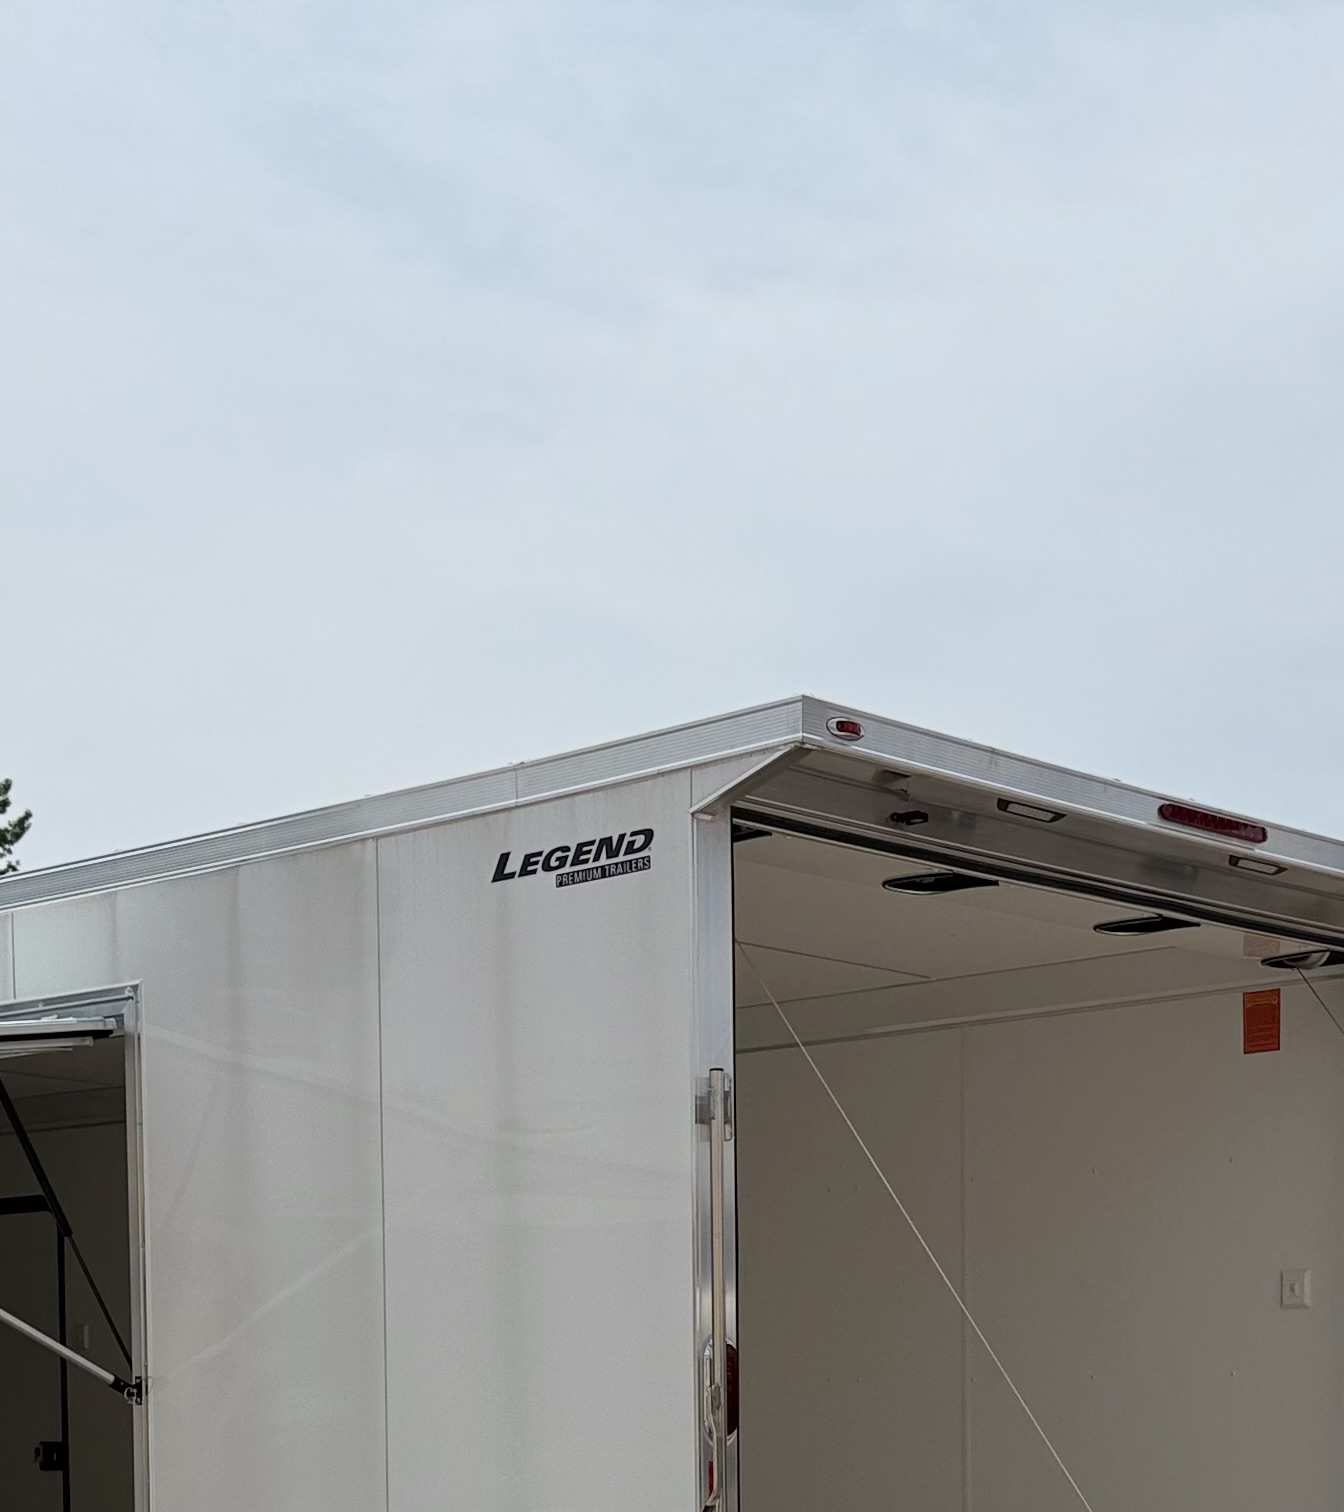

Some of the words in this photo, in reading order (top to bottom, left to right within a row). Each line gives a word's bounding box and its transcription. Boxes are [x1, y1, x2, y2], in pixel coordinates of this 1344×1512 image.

[491, 828, 654, 883] LEGEND
[556, 867, 602, 888] PREMIUM
[604, 856, 650, 877] TRAILERS
